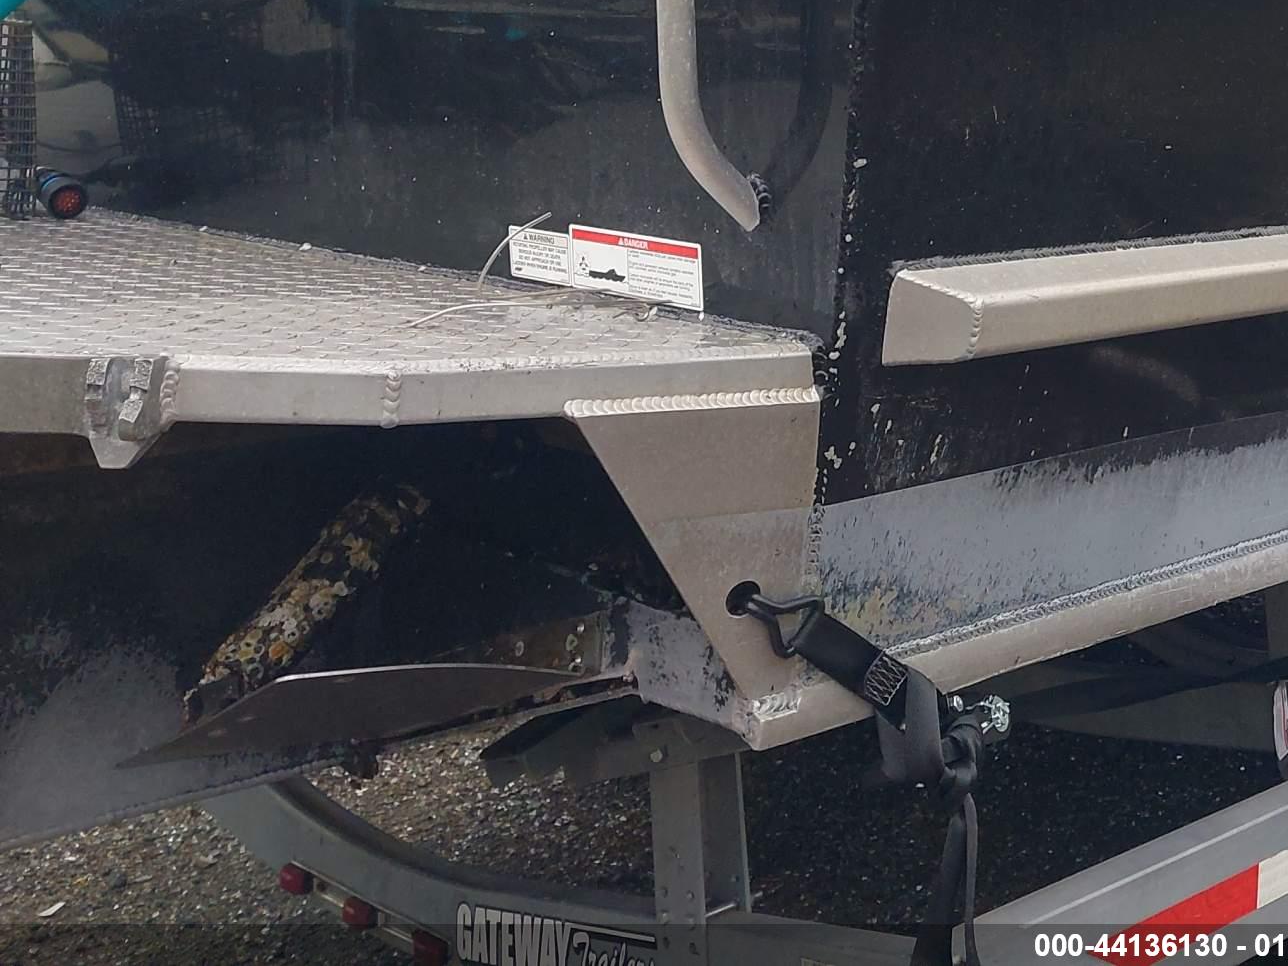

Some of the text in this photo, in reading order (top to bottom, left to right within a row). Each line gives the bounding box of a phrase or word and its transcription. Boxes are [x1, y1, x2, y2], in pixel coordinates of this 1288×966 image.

[528, 233, 555, 245] WARNING
[623, 237, 649, 250] DANGER
[456, 903, 574, 966] GATEWAY
